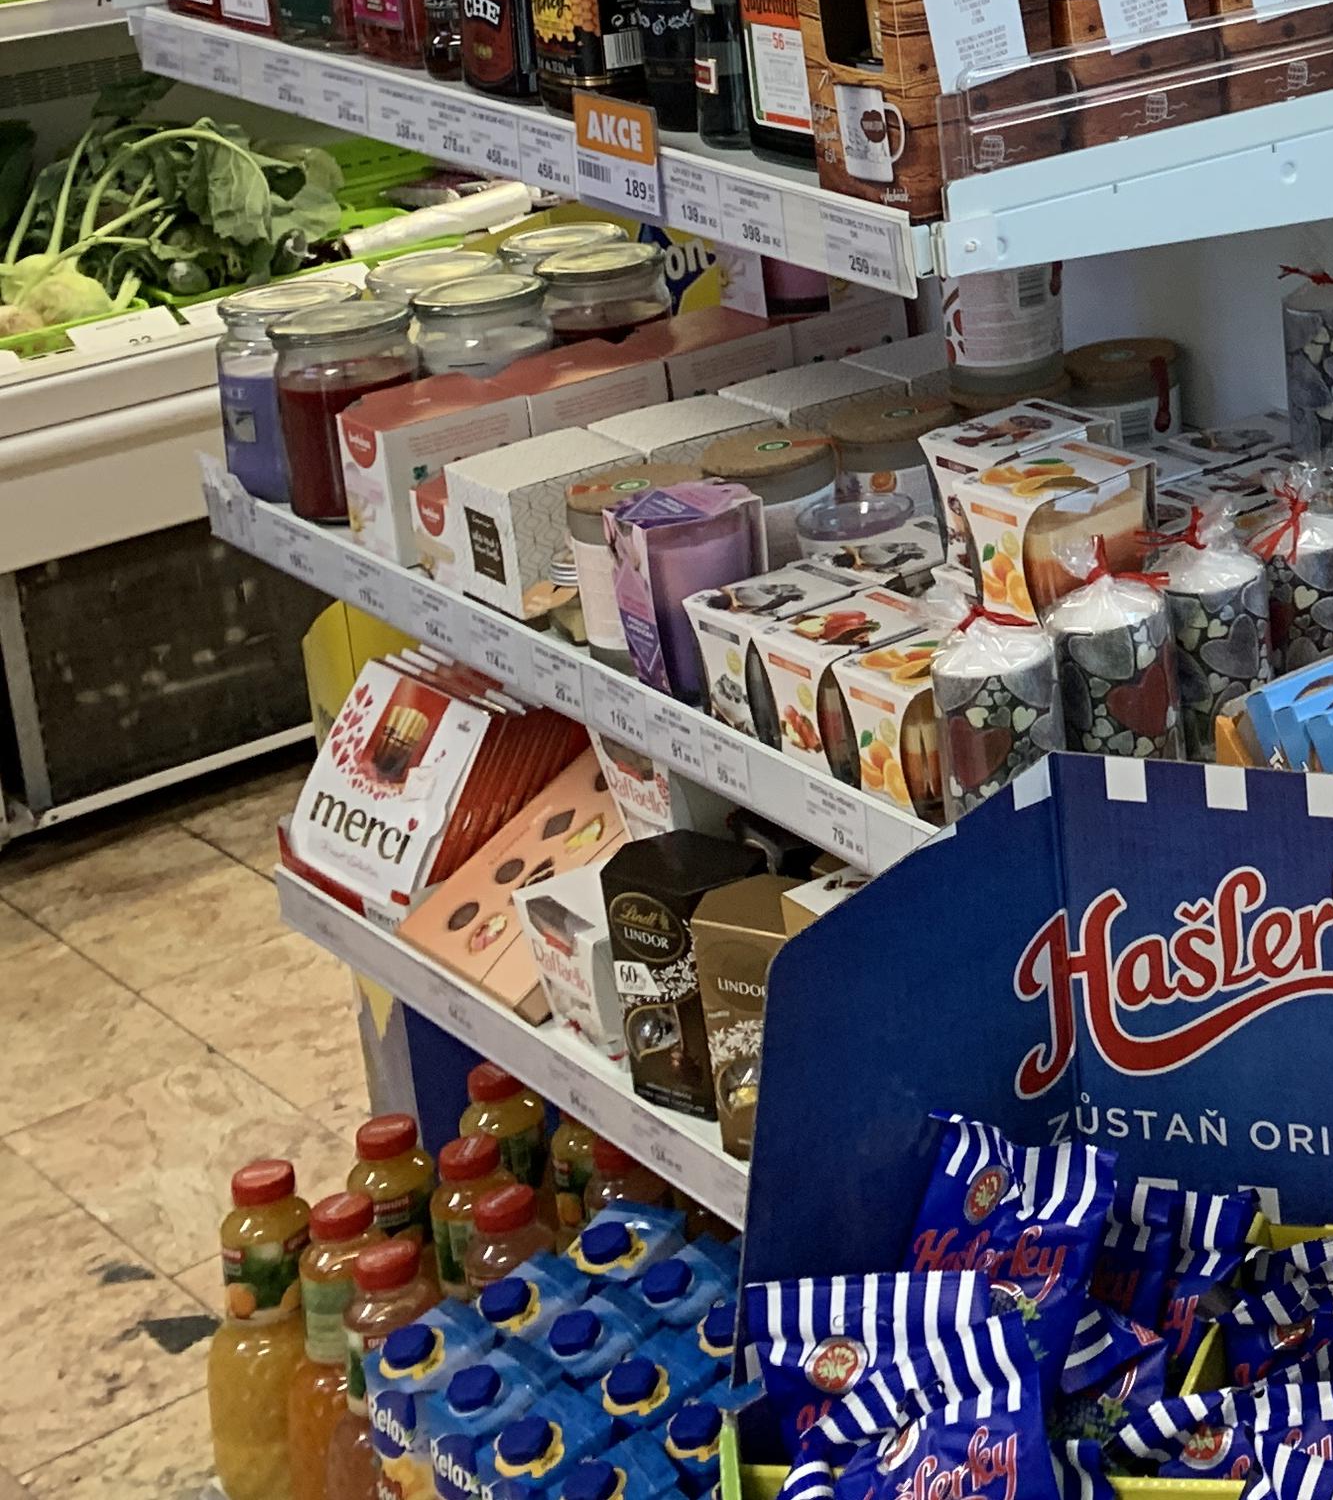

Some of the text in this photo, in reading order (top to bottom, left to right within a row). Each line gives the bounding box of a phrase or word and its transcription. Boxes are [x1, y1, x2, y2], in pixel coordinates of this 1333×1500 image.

[587, 110, 643, 153] AKCE
[310, 789, 419, 864] merci
[620, 902, 657, 924] Lindt
[624, 928, 669, 950] LINDOR
[1046, 1092, 1228, 1148] ZŮSTAŇ
[368, 1397, 417, 1451] Relax
